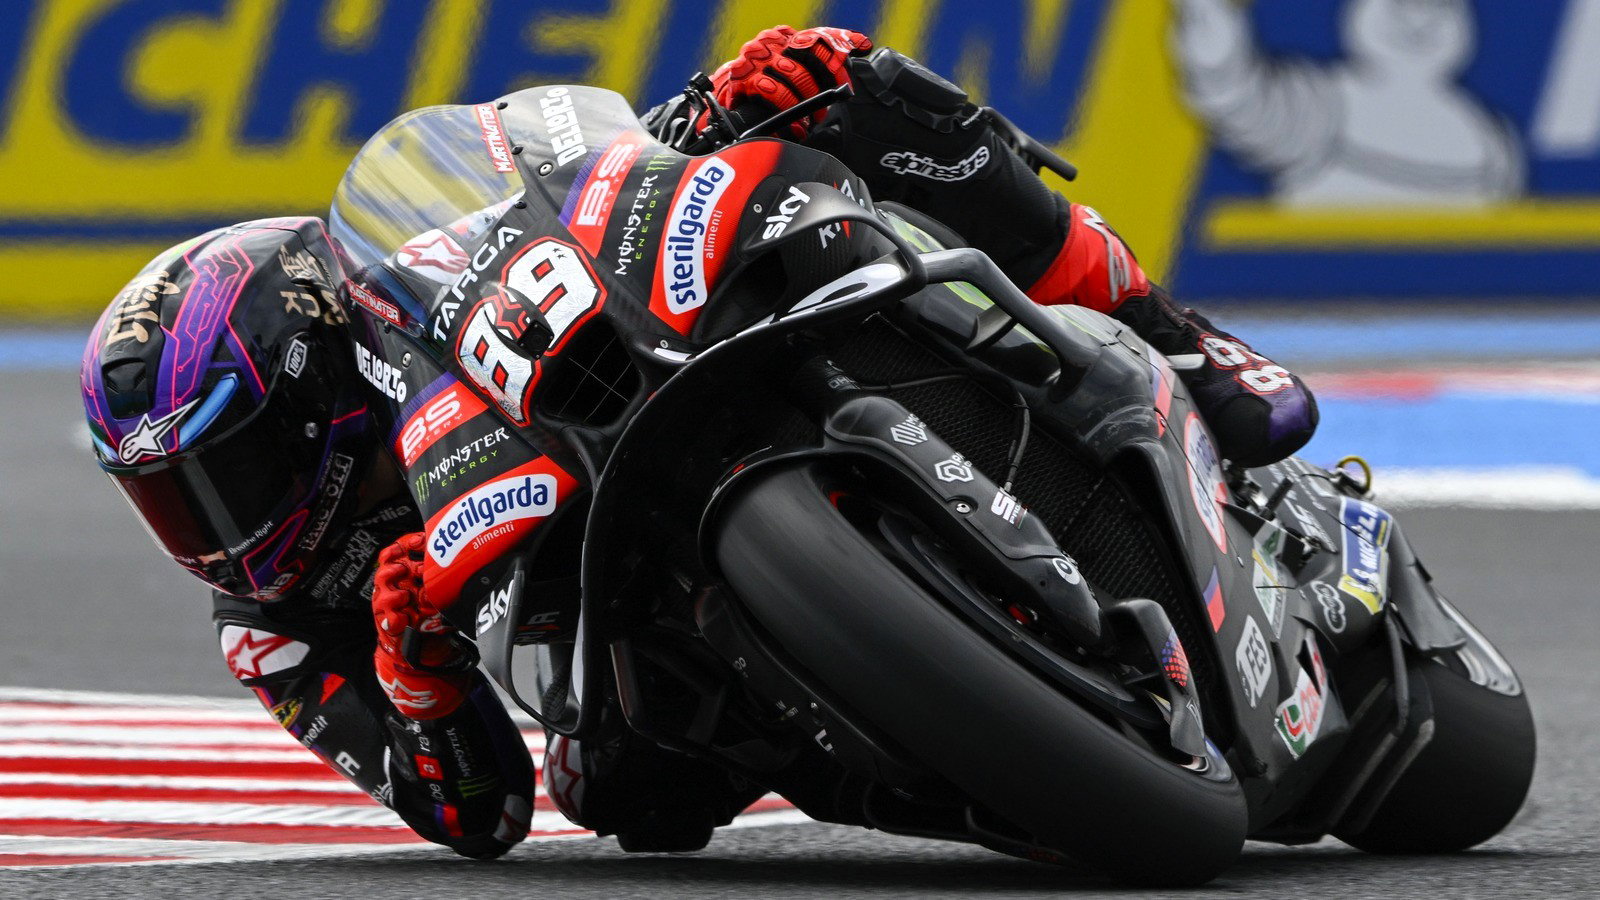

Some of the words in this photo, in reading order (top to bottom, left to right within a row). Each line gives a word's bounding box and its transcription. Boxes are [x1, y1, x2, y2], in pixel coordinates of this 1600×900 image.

[577, 144, 635, 227] BS
[763, 186, 811, 240] sky
[615, 174, 659, 276] MONSTER
[635, 189, 660, 260] ENERGY
[668, 166, 725, 305] sterilgarda
[704, 209, 723, 259] alimenti
[433, 226, 524, 343] TARGA
[456, 237, 607, 426] 89
[401, 390, 461, 461] BS
[429, 426, 510, 484] MONSTER
[441, 450, 499, 487] ENERGY
[433, 476, 549, 558] sterilgarda
[472, 521, 516, 550] alimenti
[477, 579, 517, 635] sky
